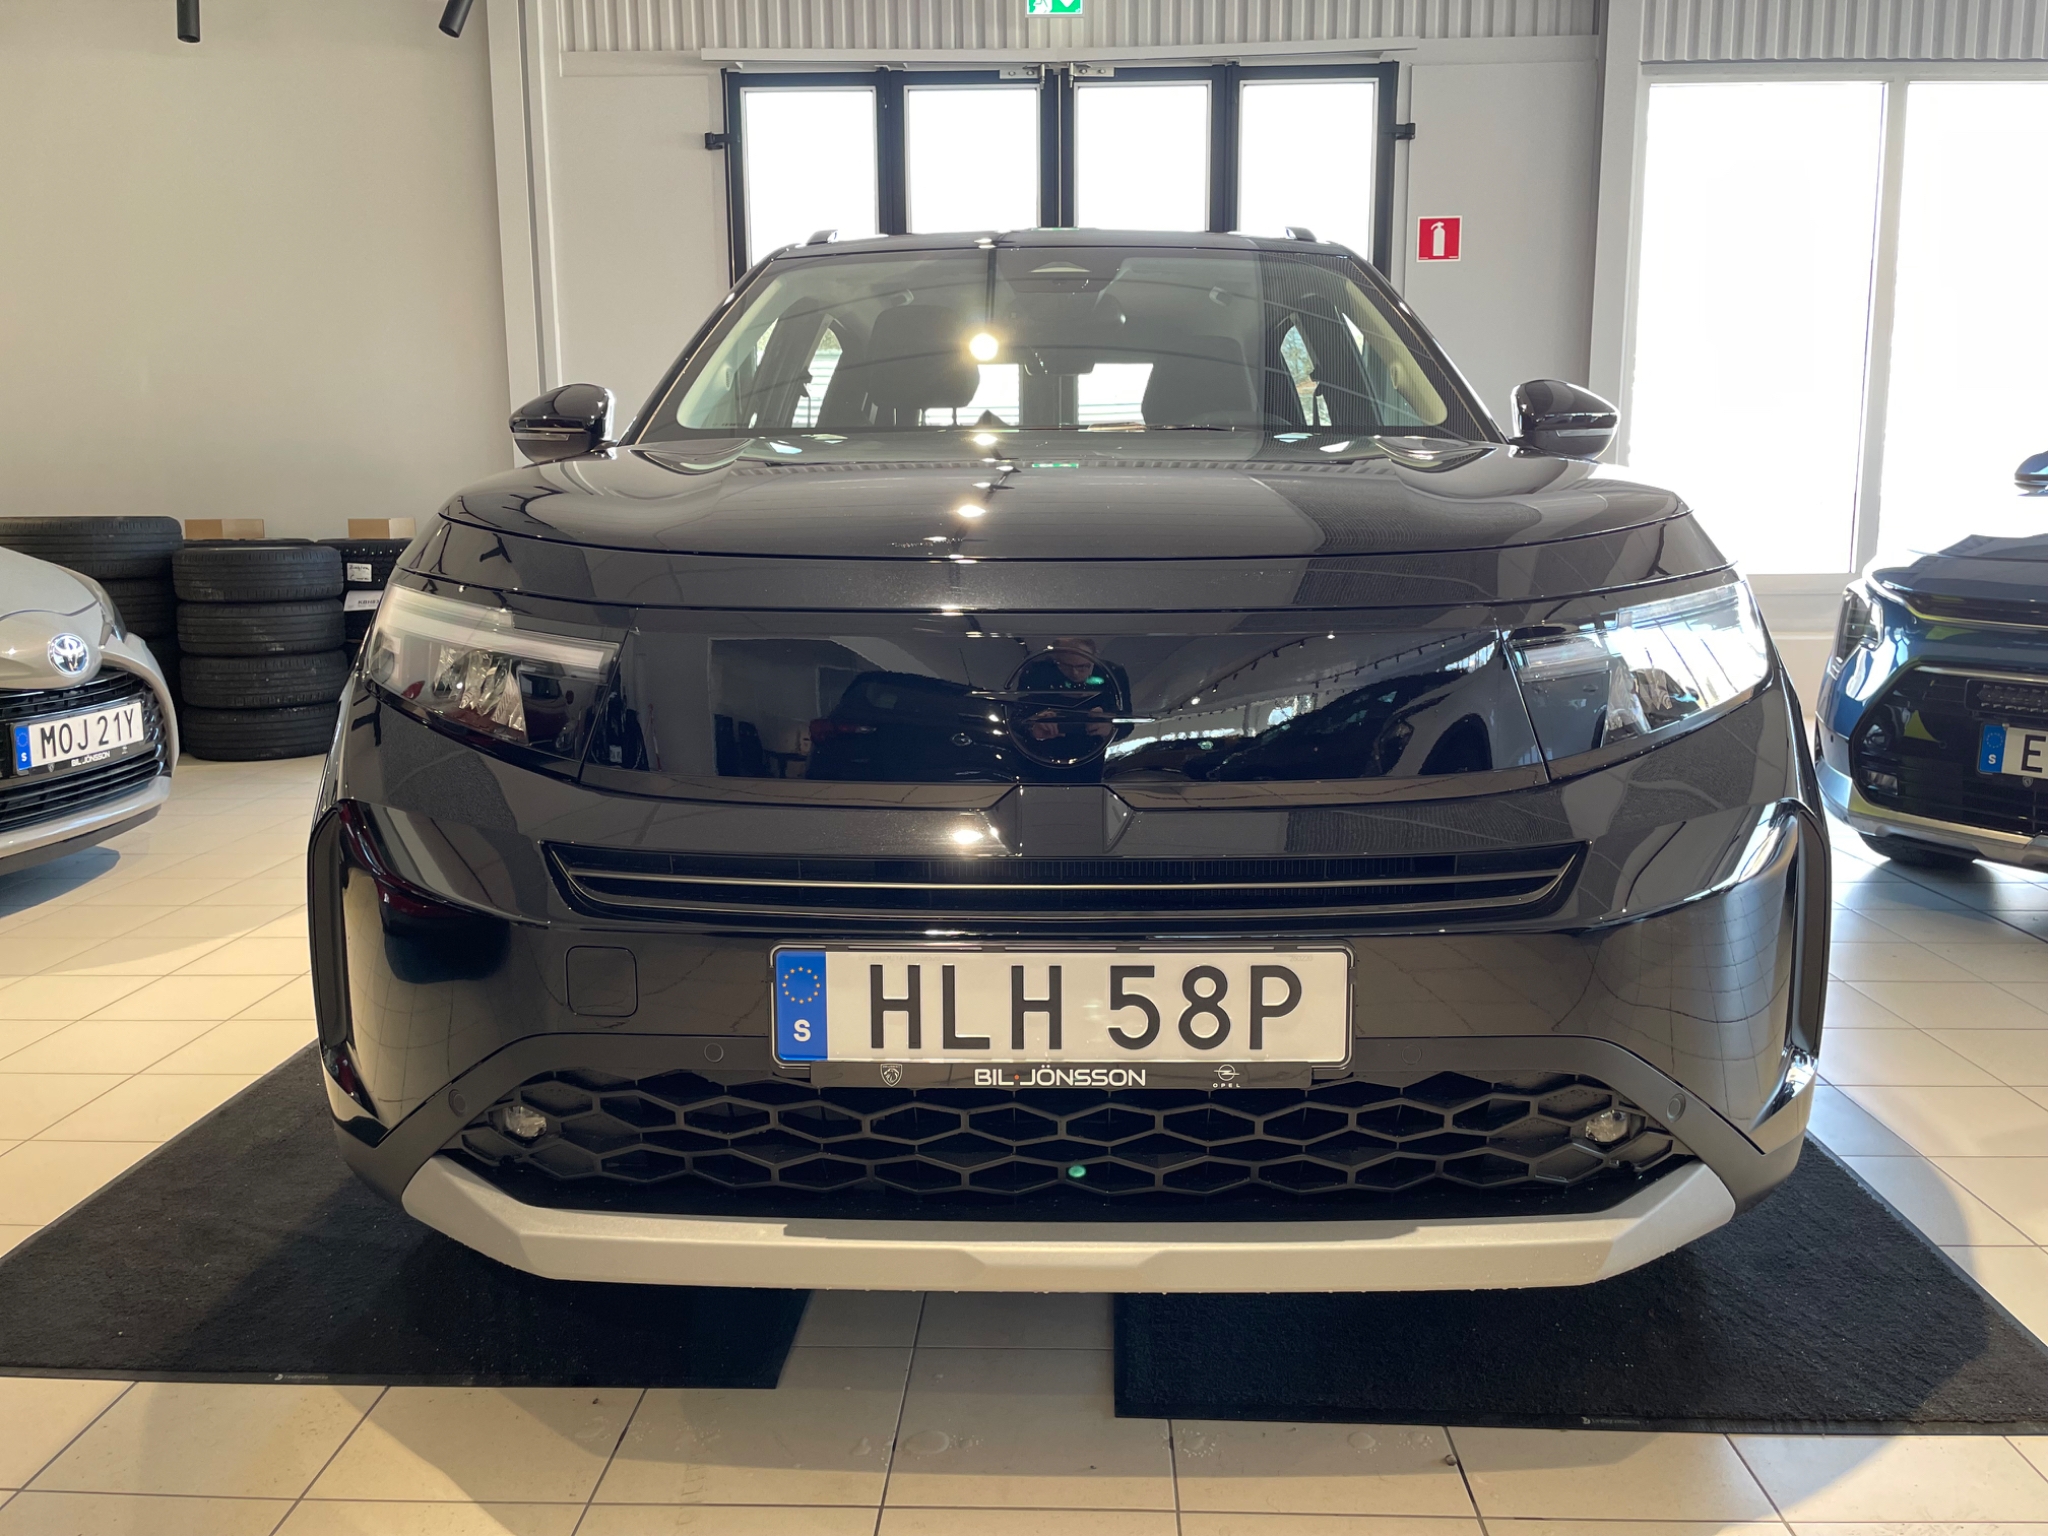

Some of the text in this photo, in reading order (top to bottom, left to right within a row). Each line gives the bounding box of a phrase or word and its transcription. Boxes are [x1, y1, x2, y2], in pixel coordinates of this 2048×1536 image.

[40, 708, 134, 759] MOJ 21Y
[21, 752, 28, 762] S
[1988, 754, 1996, 765] S
[2021, 734, 2047, 773] E
[870, 964, 1302, 1050] HLH 58P
[793, 1019, 811, 1042] S
